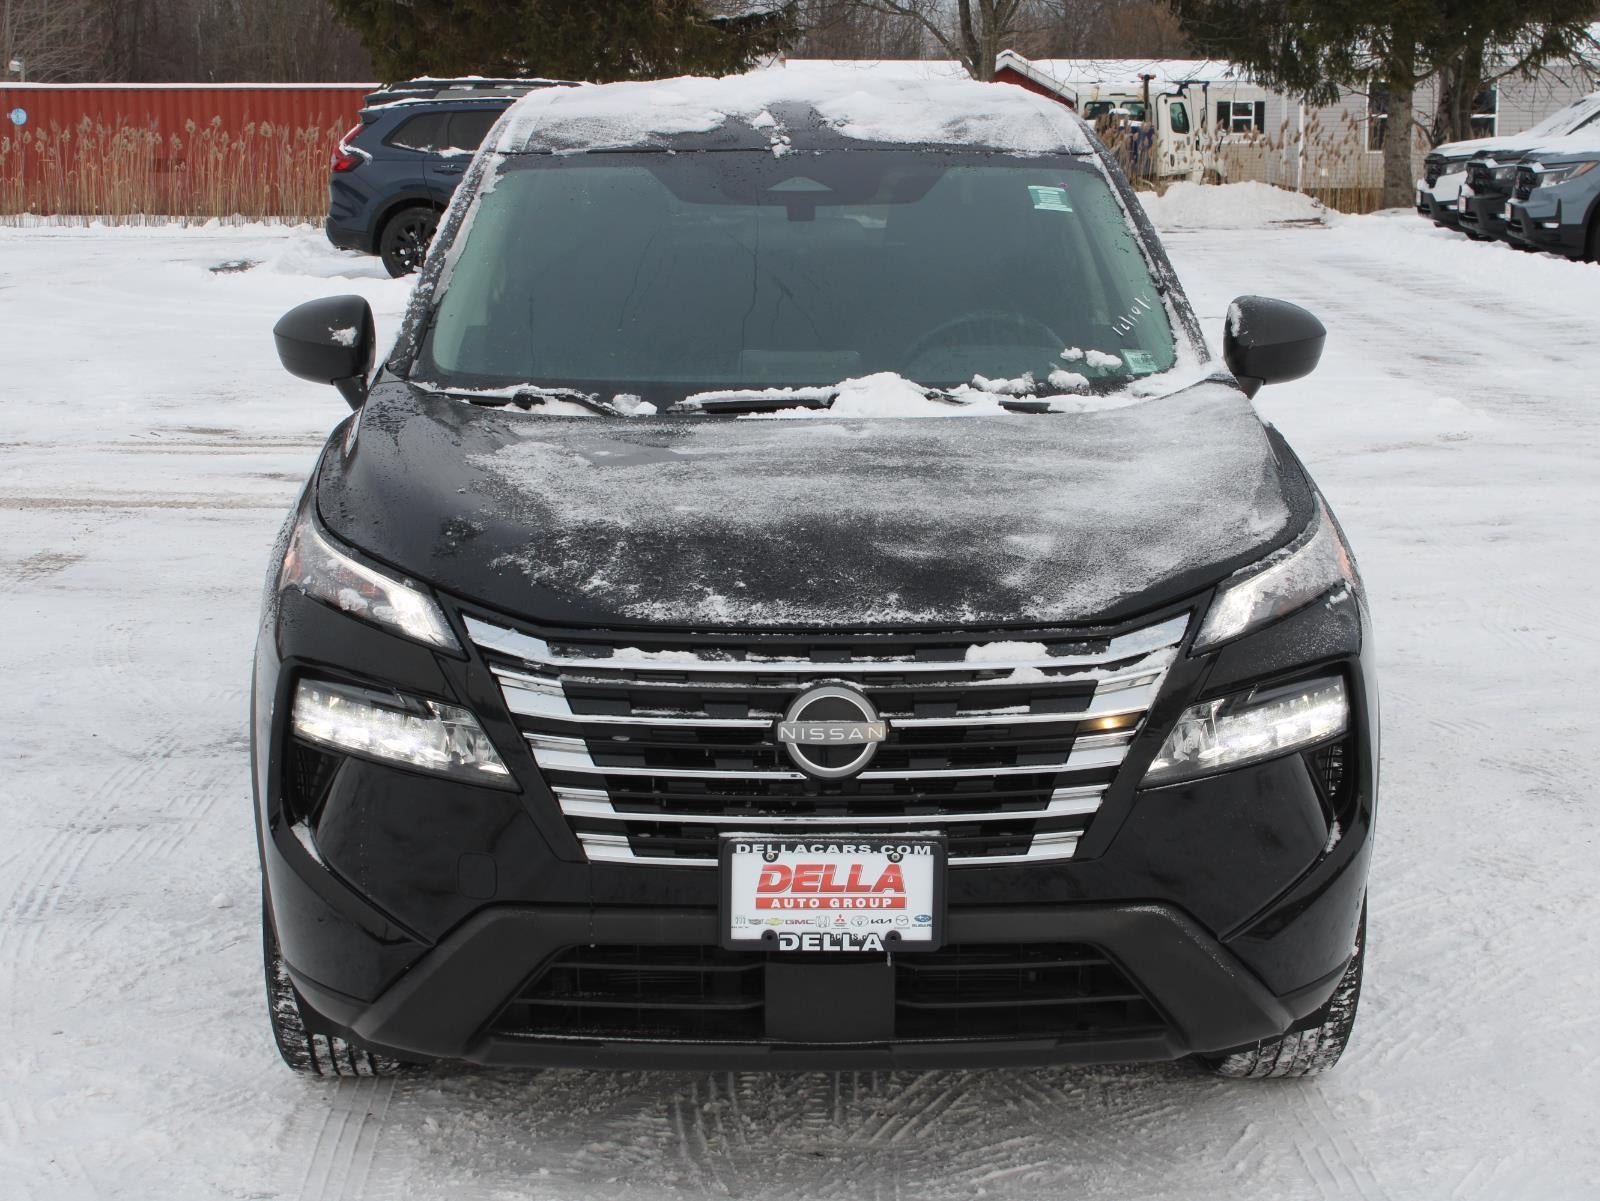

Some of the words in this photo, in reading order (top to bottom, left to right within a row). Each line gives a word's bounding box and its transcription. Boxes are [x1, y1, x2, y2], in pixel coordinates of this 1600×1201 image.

[780, 726, 883, 740] NISSAN
[736, 843, 932, 856] DELLACARS.COM
[756, 863, 906, 894] DELLA
[770, 898, 820, 909] AUTO
[829, 898, 892, 908] GROUP
[778, 932, 885, 951] DELLA
